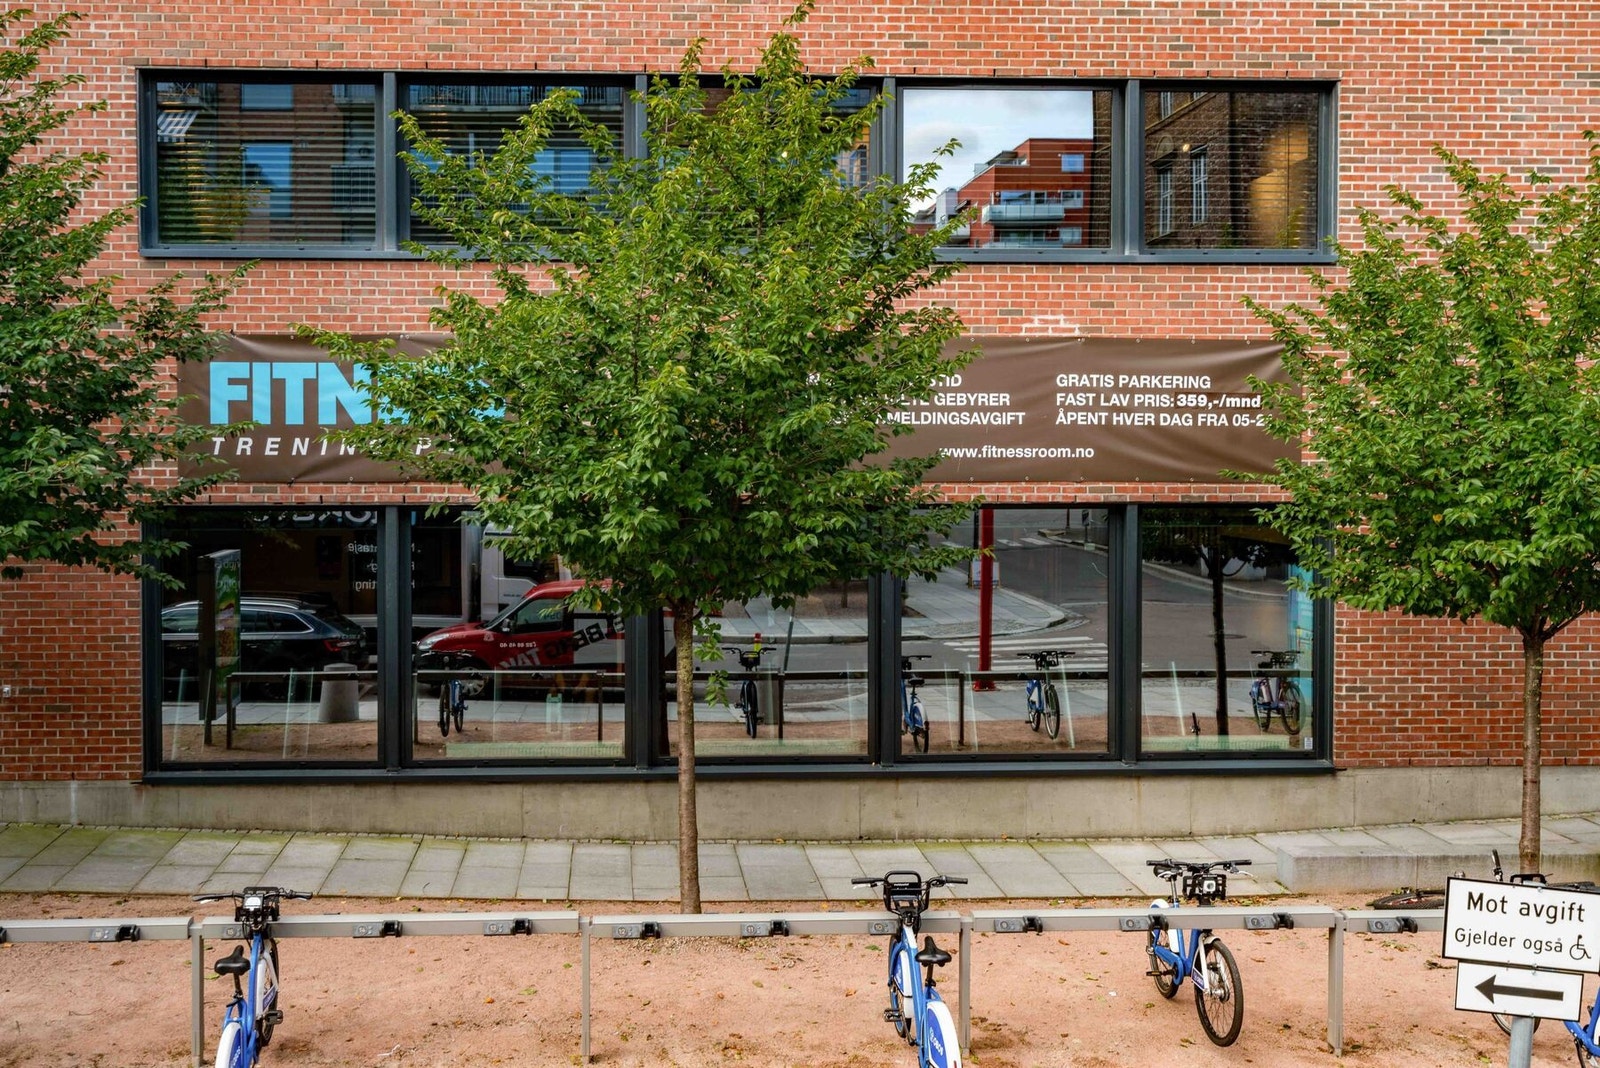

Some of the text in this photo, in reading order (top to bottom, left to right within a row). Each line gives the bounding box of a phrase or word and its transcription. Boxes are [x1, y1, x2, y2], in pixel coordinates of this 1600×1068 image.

[1056, 374, 1212, 389] GRATIS PARKERING
[934, 392, 1011, 406] GEBYRER
[1056, 393, 1262, 410] FAST LAV PRIS: 359,-/mnd
[1055, 408, 1108, 425] ÅPENT
[1112, 412, 1155, 426] HVER
[1159, 412, 1193, 427] DAG
[1197, 413, 1229, 427] FRA
[939, 445, 1095, 459] www.fitnessroom.no
[1467, 891, 1586, 925] Mot avgift
[1454, 927, 1563, 955] Gjelder også
